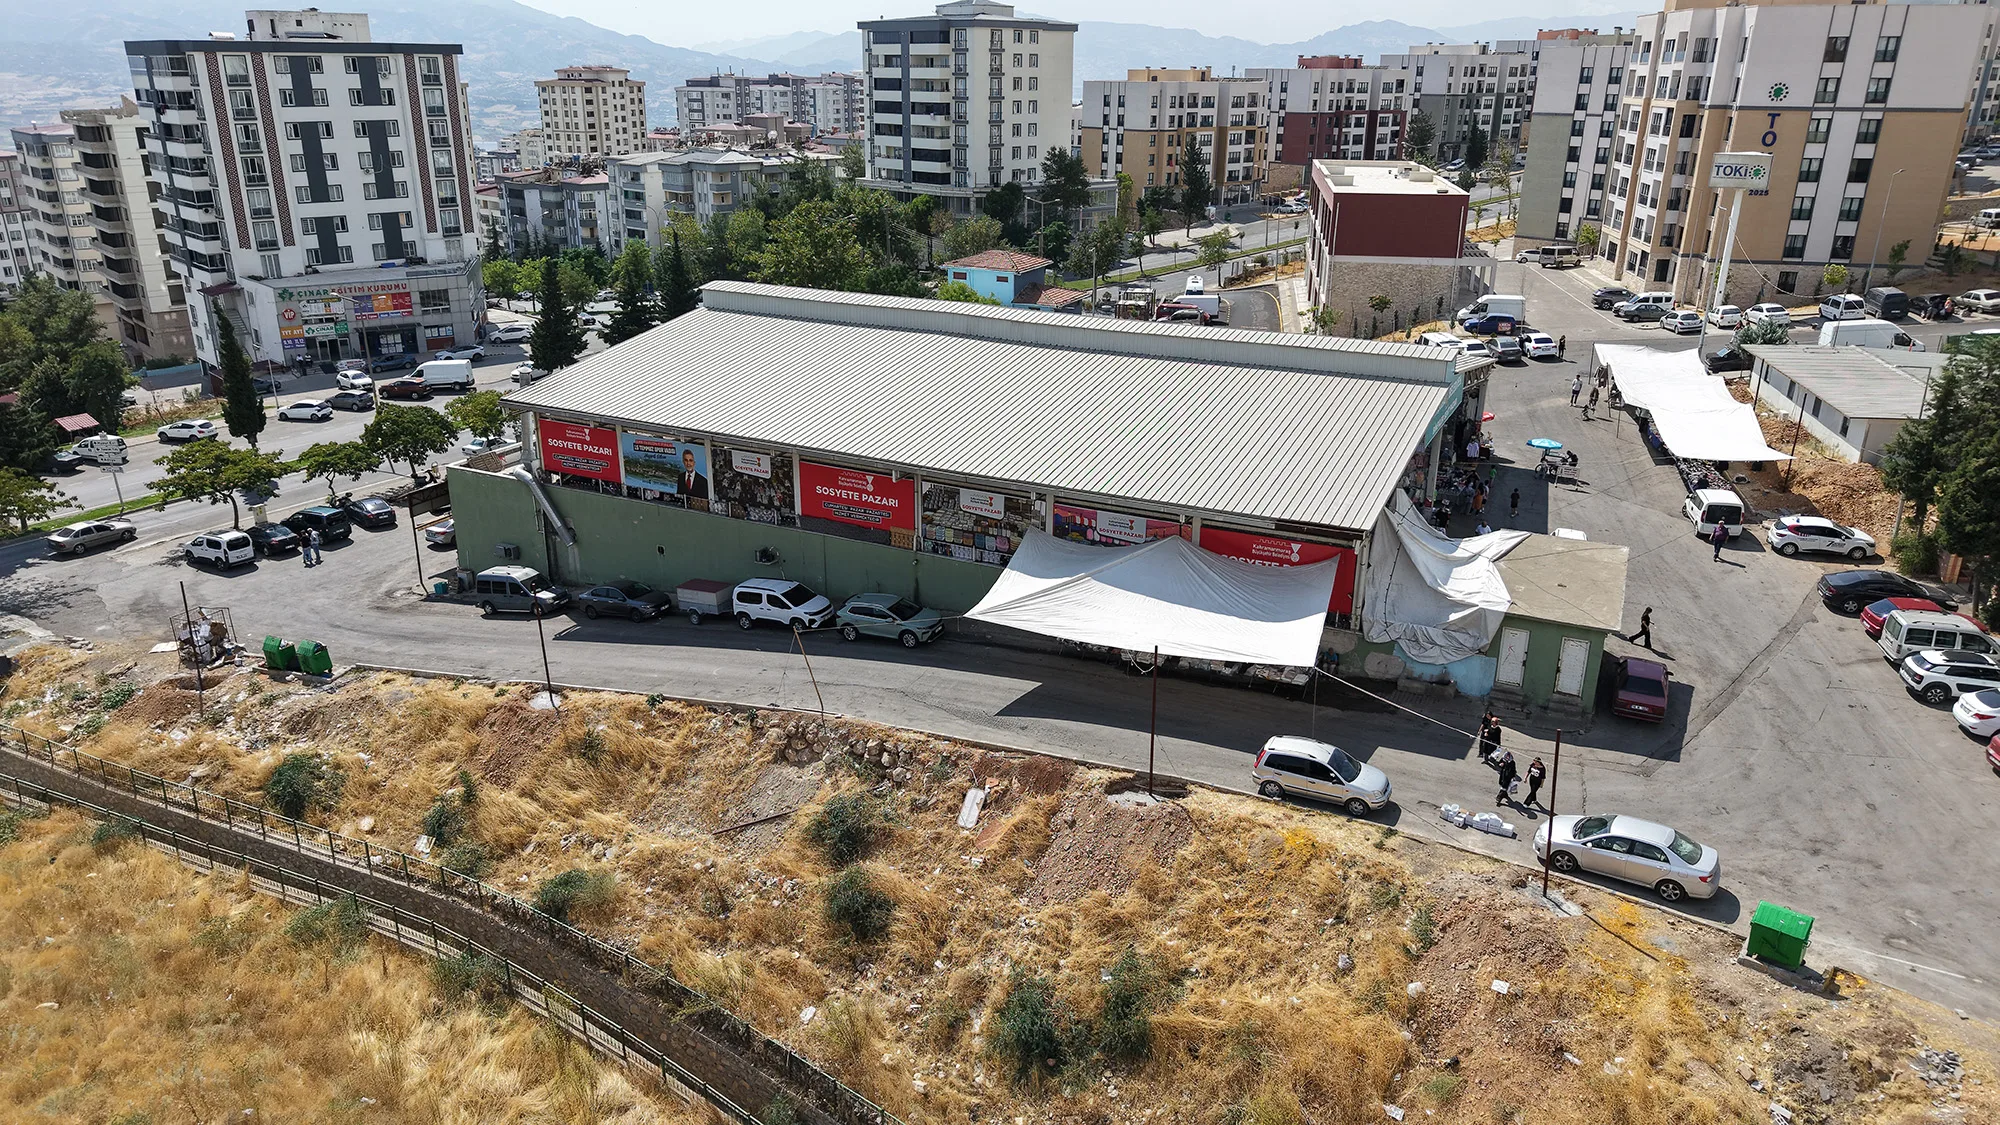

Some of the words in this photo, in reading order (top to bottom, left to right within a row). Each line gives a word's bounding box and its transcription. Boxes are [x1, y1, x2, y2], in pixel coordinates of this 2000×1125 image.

[367, 283, 407, 292] KURUMU
[548, 438, 582, 451] SOSYETE
[583, 445, 612, 456] PAZARI
[815, 485, 860, 500] SOSYETE
[862, 493, 898, 507] PAZARI
